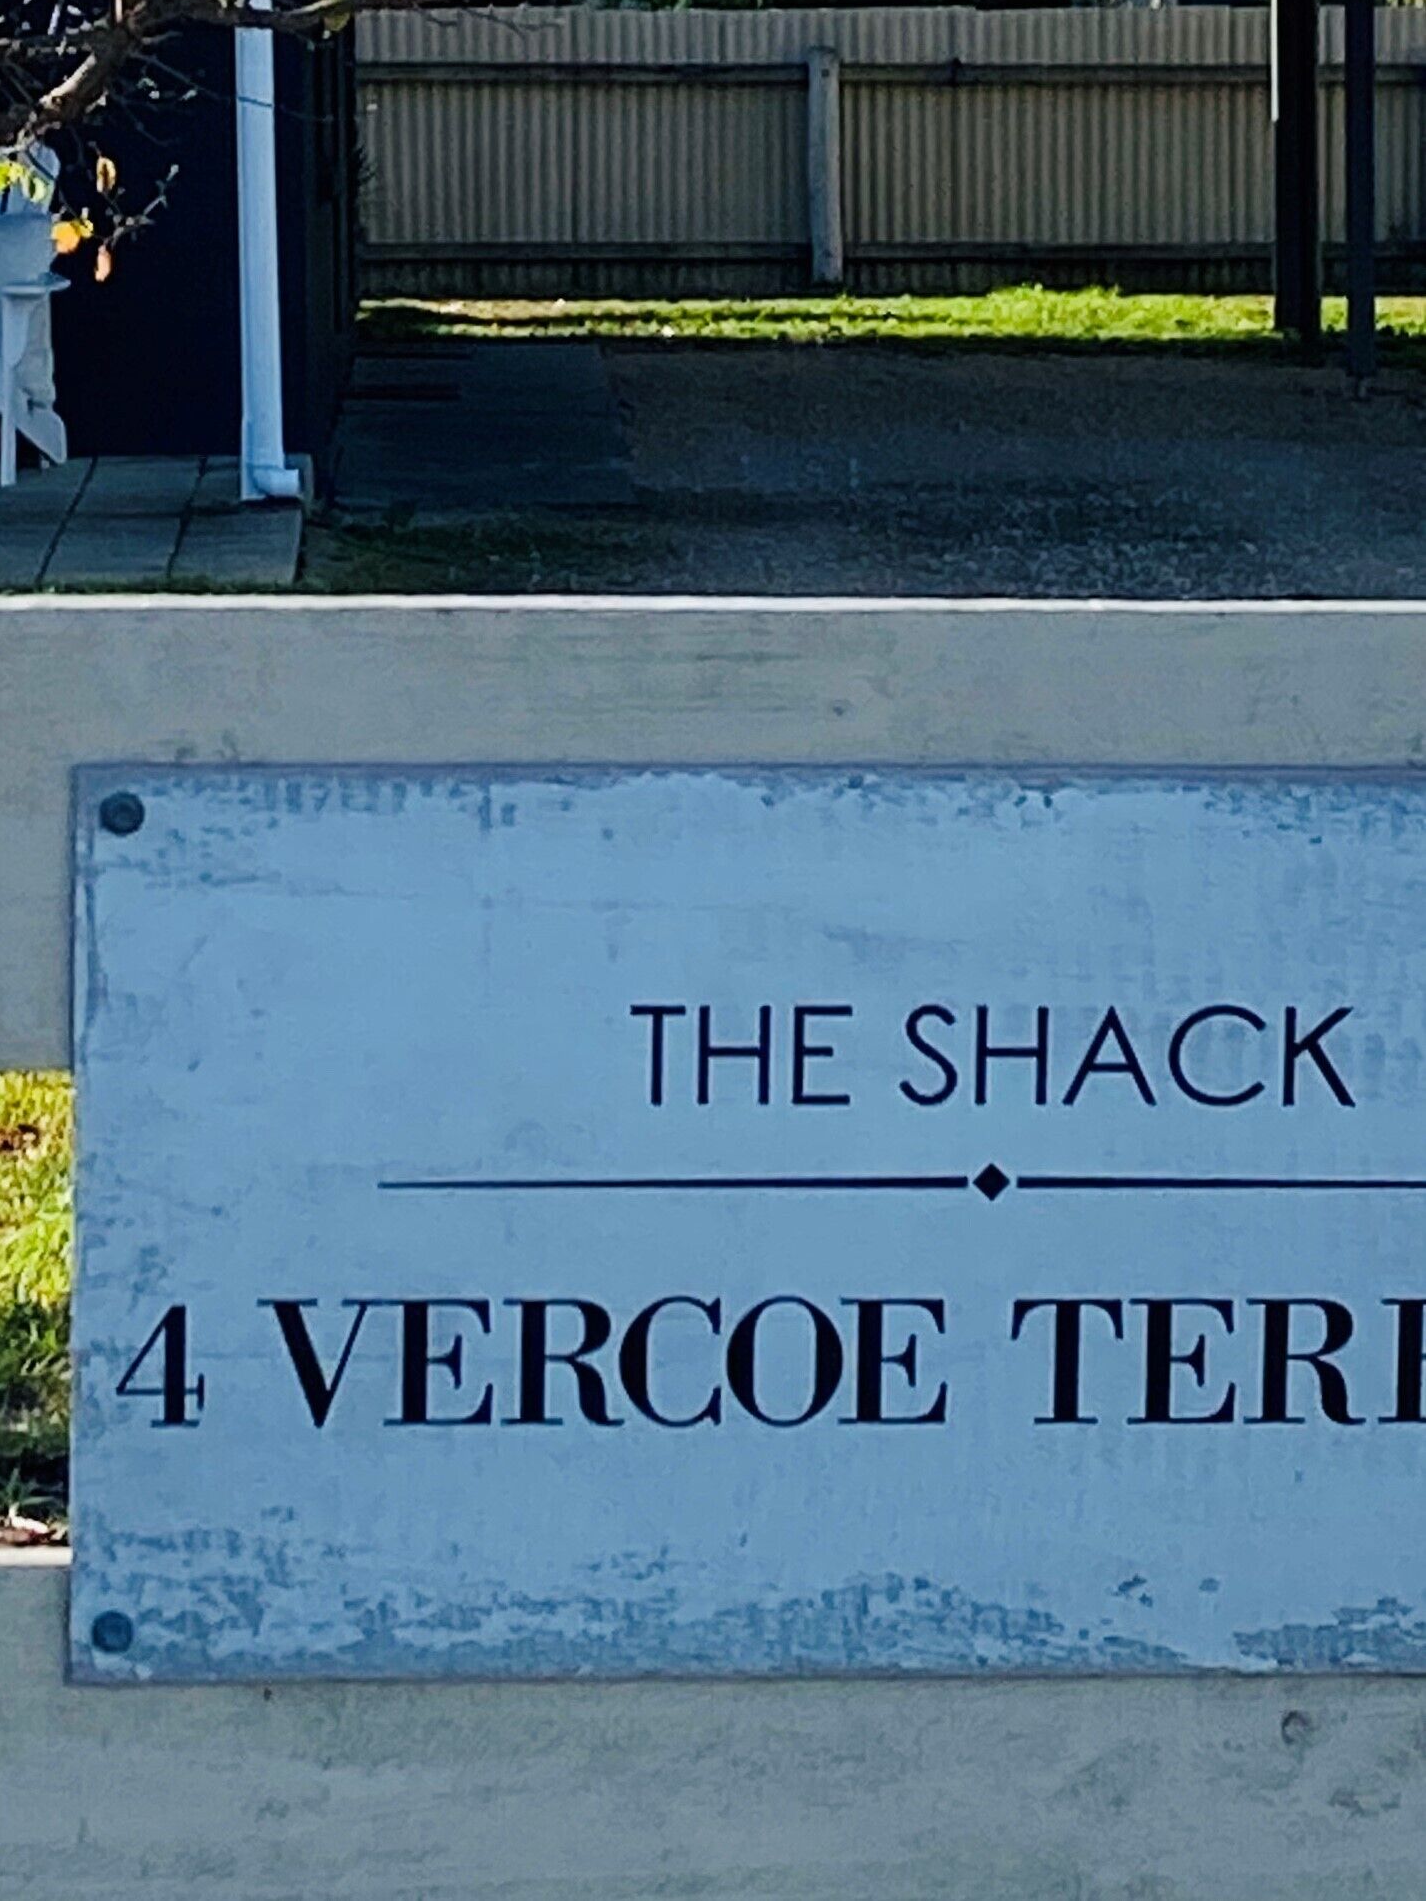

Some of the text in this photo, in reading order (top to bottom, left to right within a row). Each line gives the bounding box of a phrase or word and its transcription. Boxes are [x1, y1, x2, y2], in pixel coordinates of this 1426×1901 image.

[629, 1003, 1357, 1108] THE SHACK
[115, 1303, 206, 1429] 4
[256, 1295, 948, 1429] VERCOE
